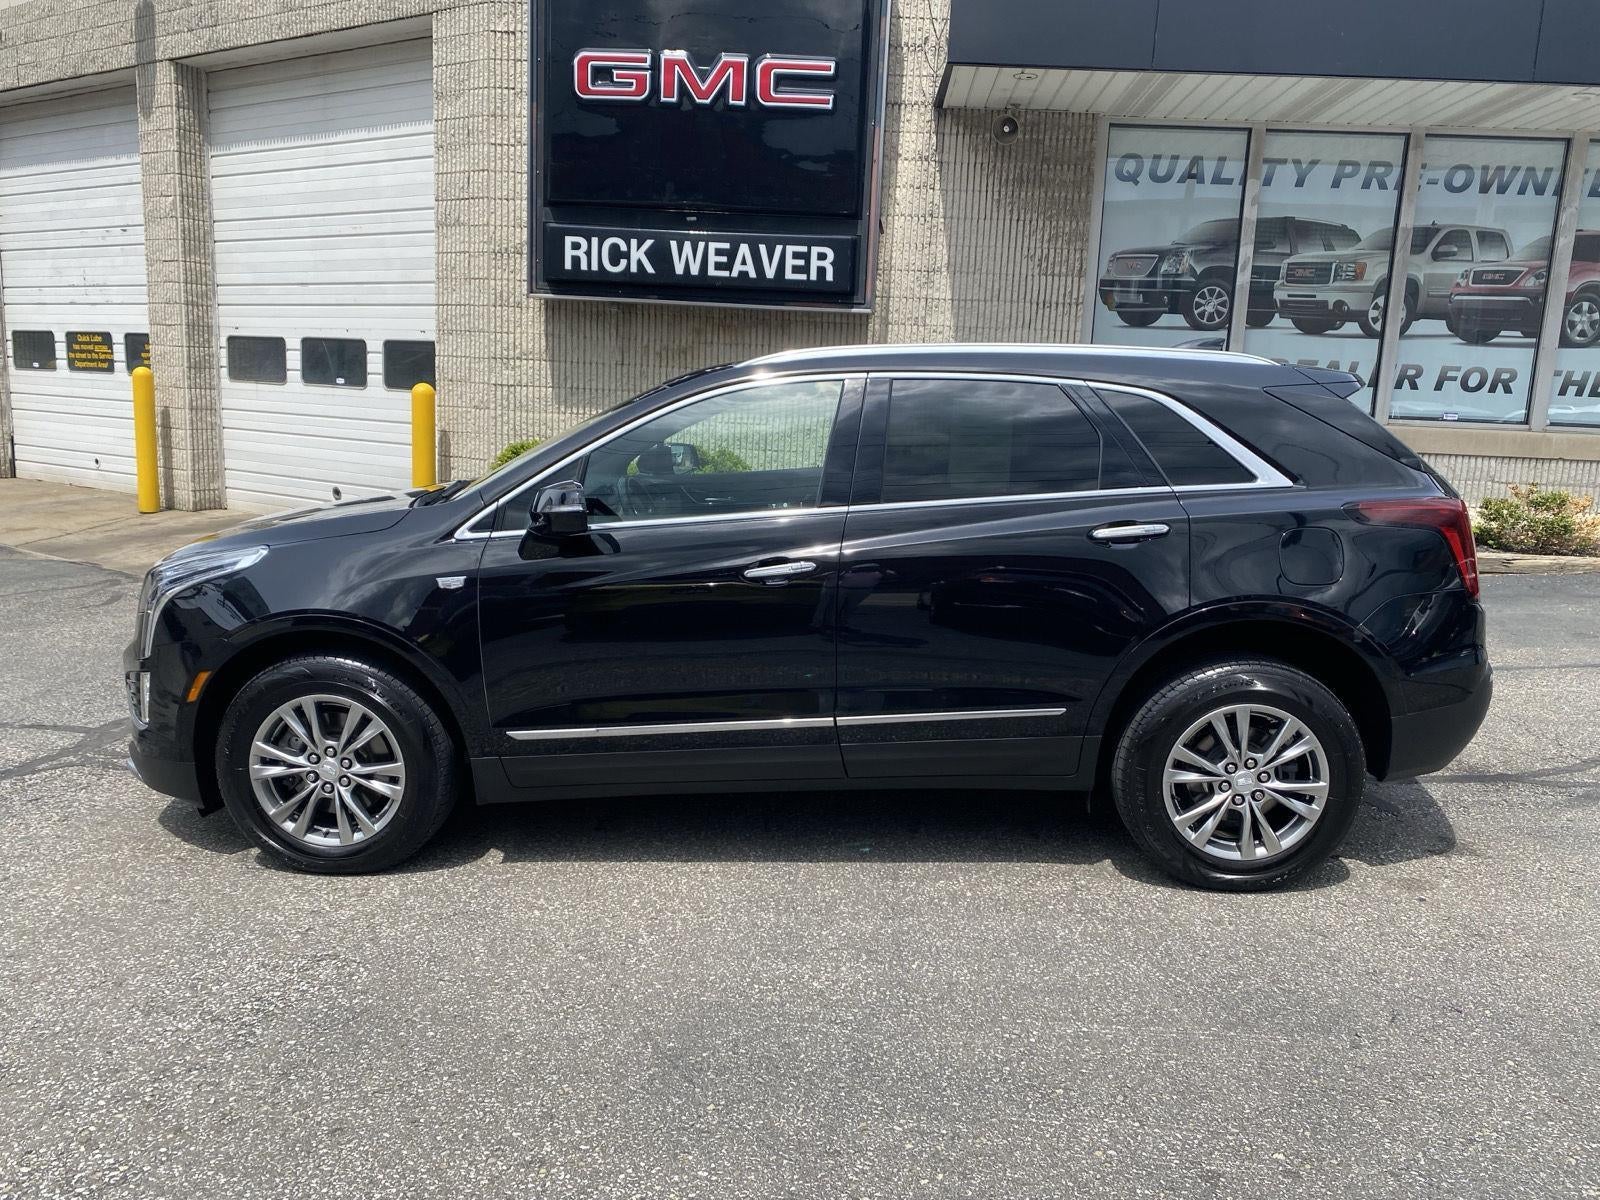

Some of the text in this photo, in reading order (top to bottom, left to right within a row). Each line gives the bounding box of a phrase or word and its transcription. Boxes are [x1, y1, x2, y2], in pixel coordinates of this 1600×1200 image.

[573, 49, 837, 109] GMC
[1114, 153, 1320, 188] QUALTY
[564, 235, 835, 281] RICK WEAVER
[1434, 365, 1518, 394] FOR
